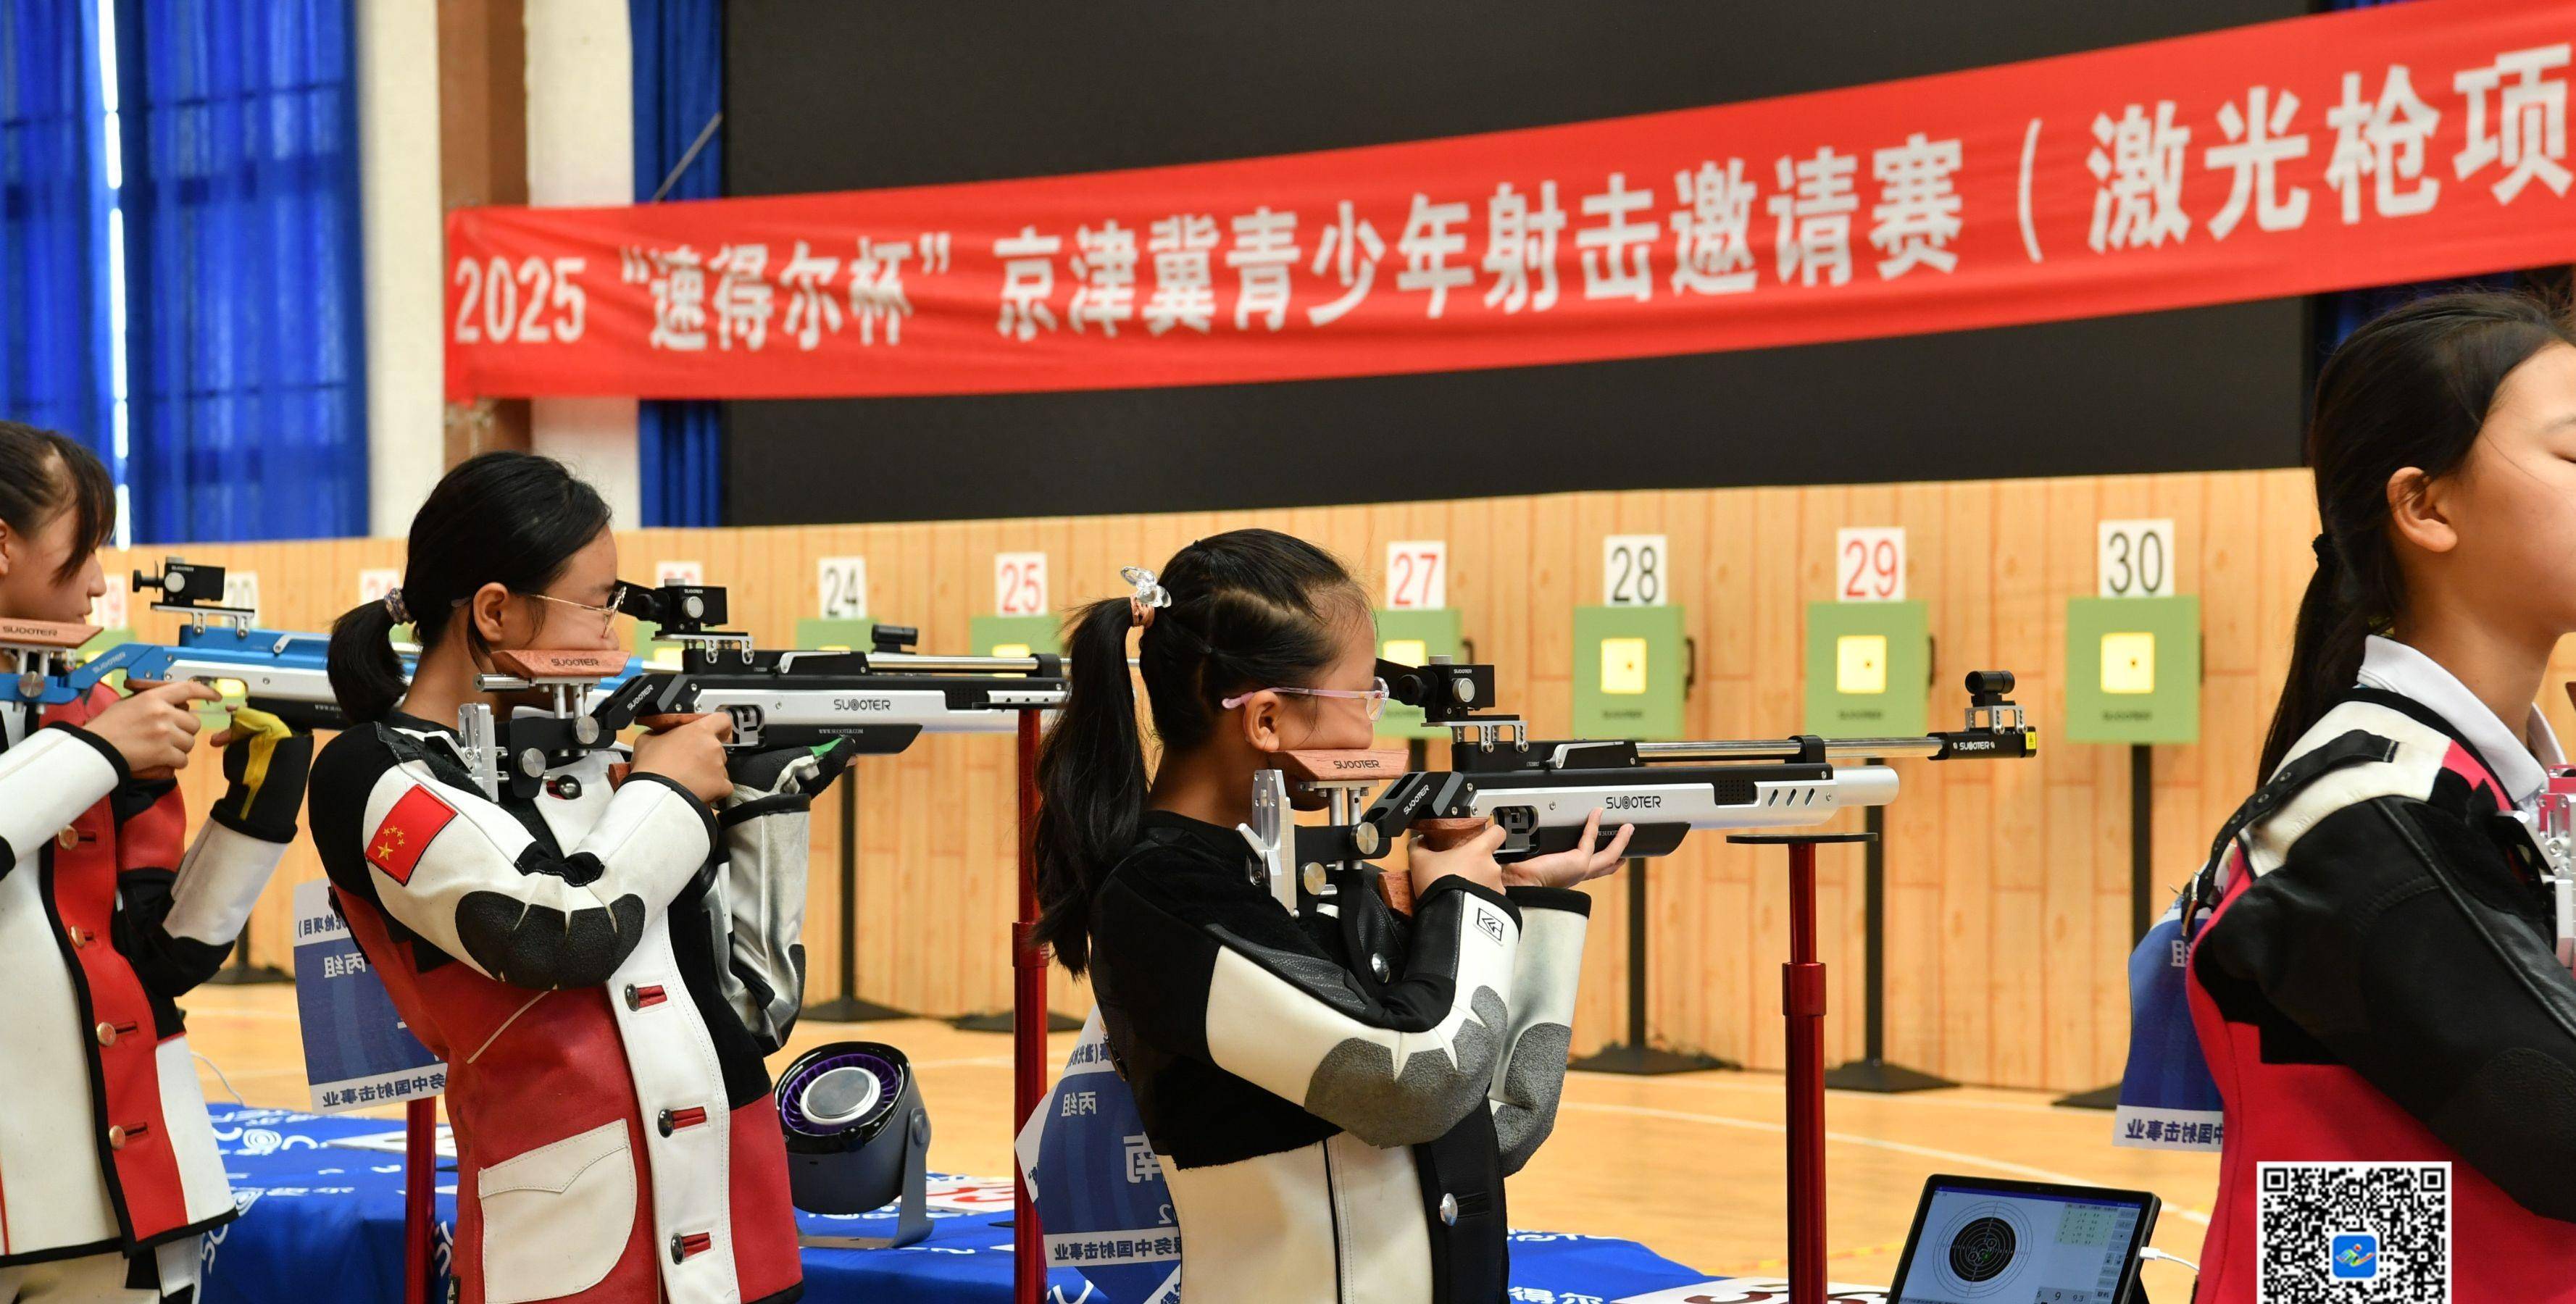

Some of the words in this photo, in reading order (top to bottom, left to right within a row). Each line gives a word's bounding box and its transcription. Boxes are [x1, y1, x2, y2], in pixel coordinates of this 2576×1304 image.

[454, 256, 585, 343] 2025
[1001, 561, 1041, 613] 25
[1393, 551, 1438, 607] 27
[1612, 546, 1659, 603] 28
[1845, 539, 1898, 598] 29
[2108, 530, 2164, 595] 30
[825, 566, 858, 617] 24
